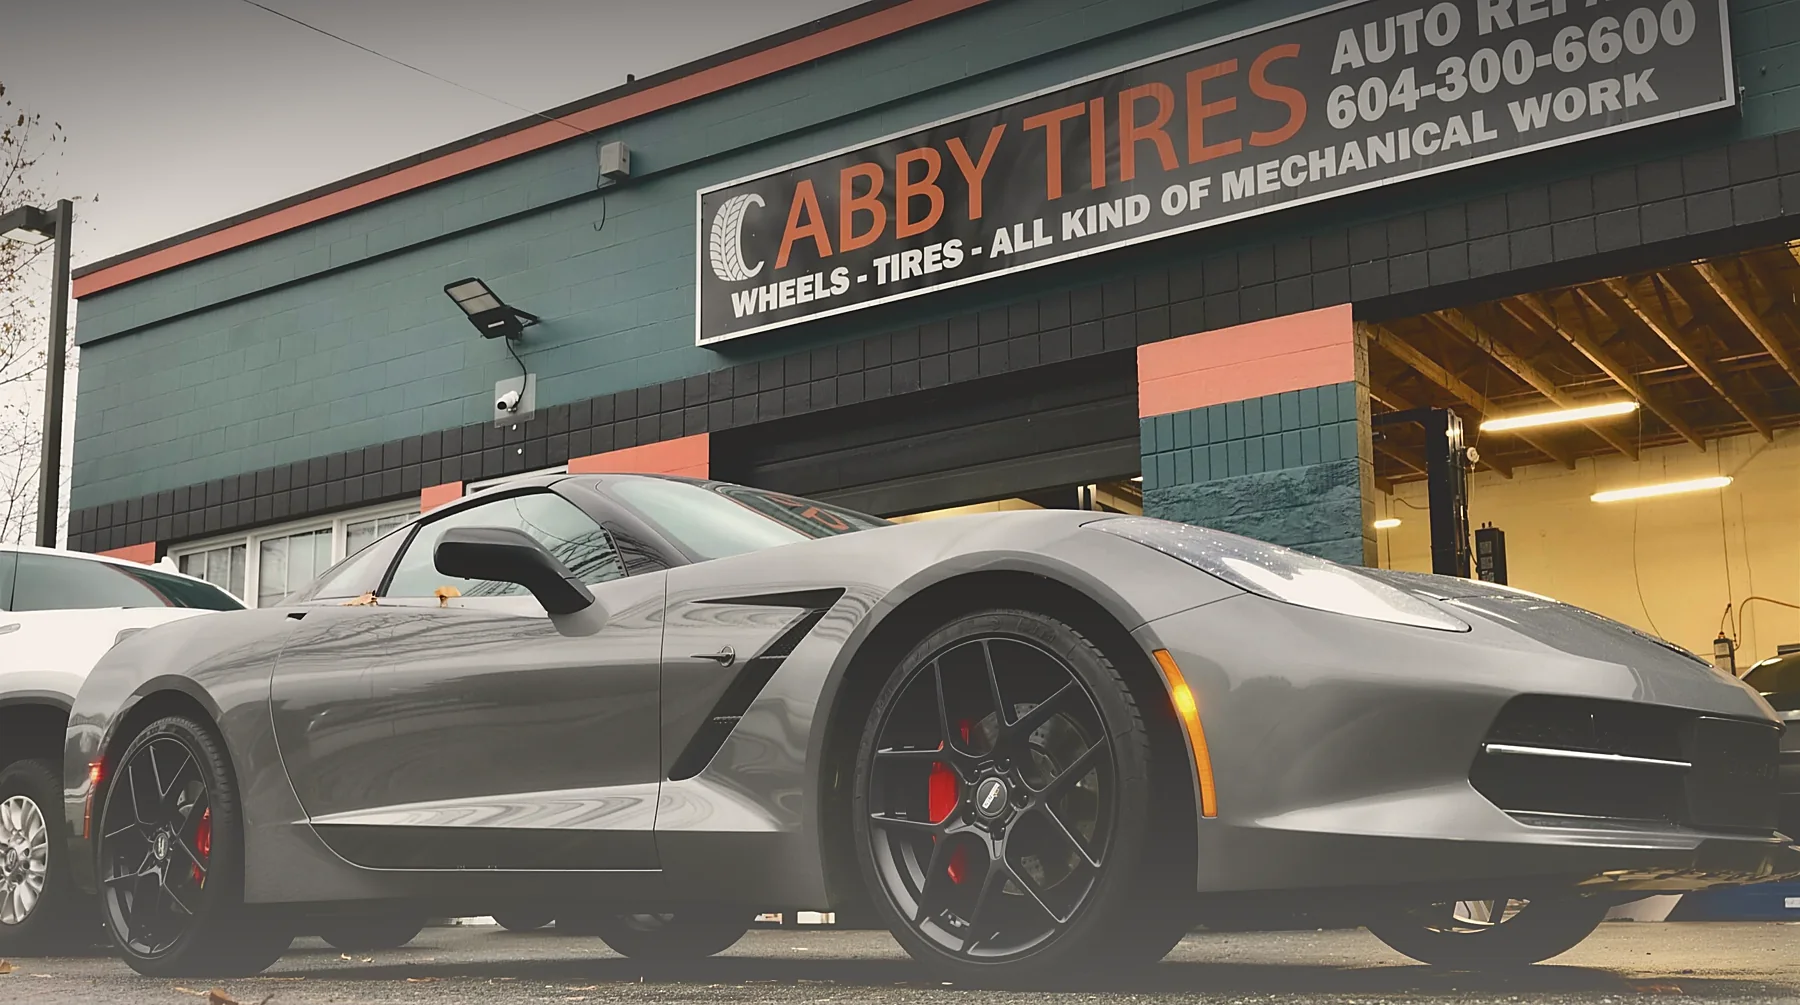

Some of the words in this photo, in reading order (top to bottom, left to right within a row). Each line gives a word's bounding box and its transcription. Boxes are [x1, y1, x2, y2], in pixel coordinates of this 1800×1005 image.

[1326, 0, 1696, 129] 604-300-6600
[1331, 2, 1461, 74] AUTO
[731, 266, 850, 318] WHEELS
[873, 239, 964, 285] TIRES
[990, 222, 1053, 257] ALL
[1062, 194, 1150, 241] KIND
[1160, 176, 1212, 216] OF
[1221, 110, 1498, 203] MECHANICAL
[1507, 68, 1659, 132] WORK
[774, 124, 1007, 269] ABBY
[1023, 43, 1307, 200] TIRES
